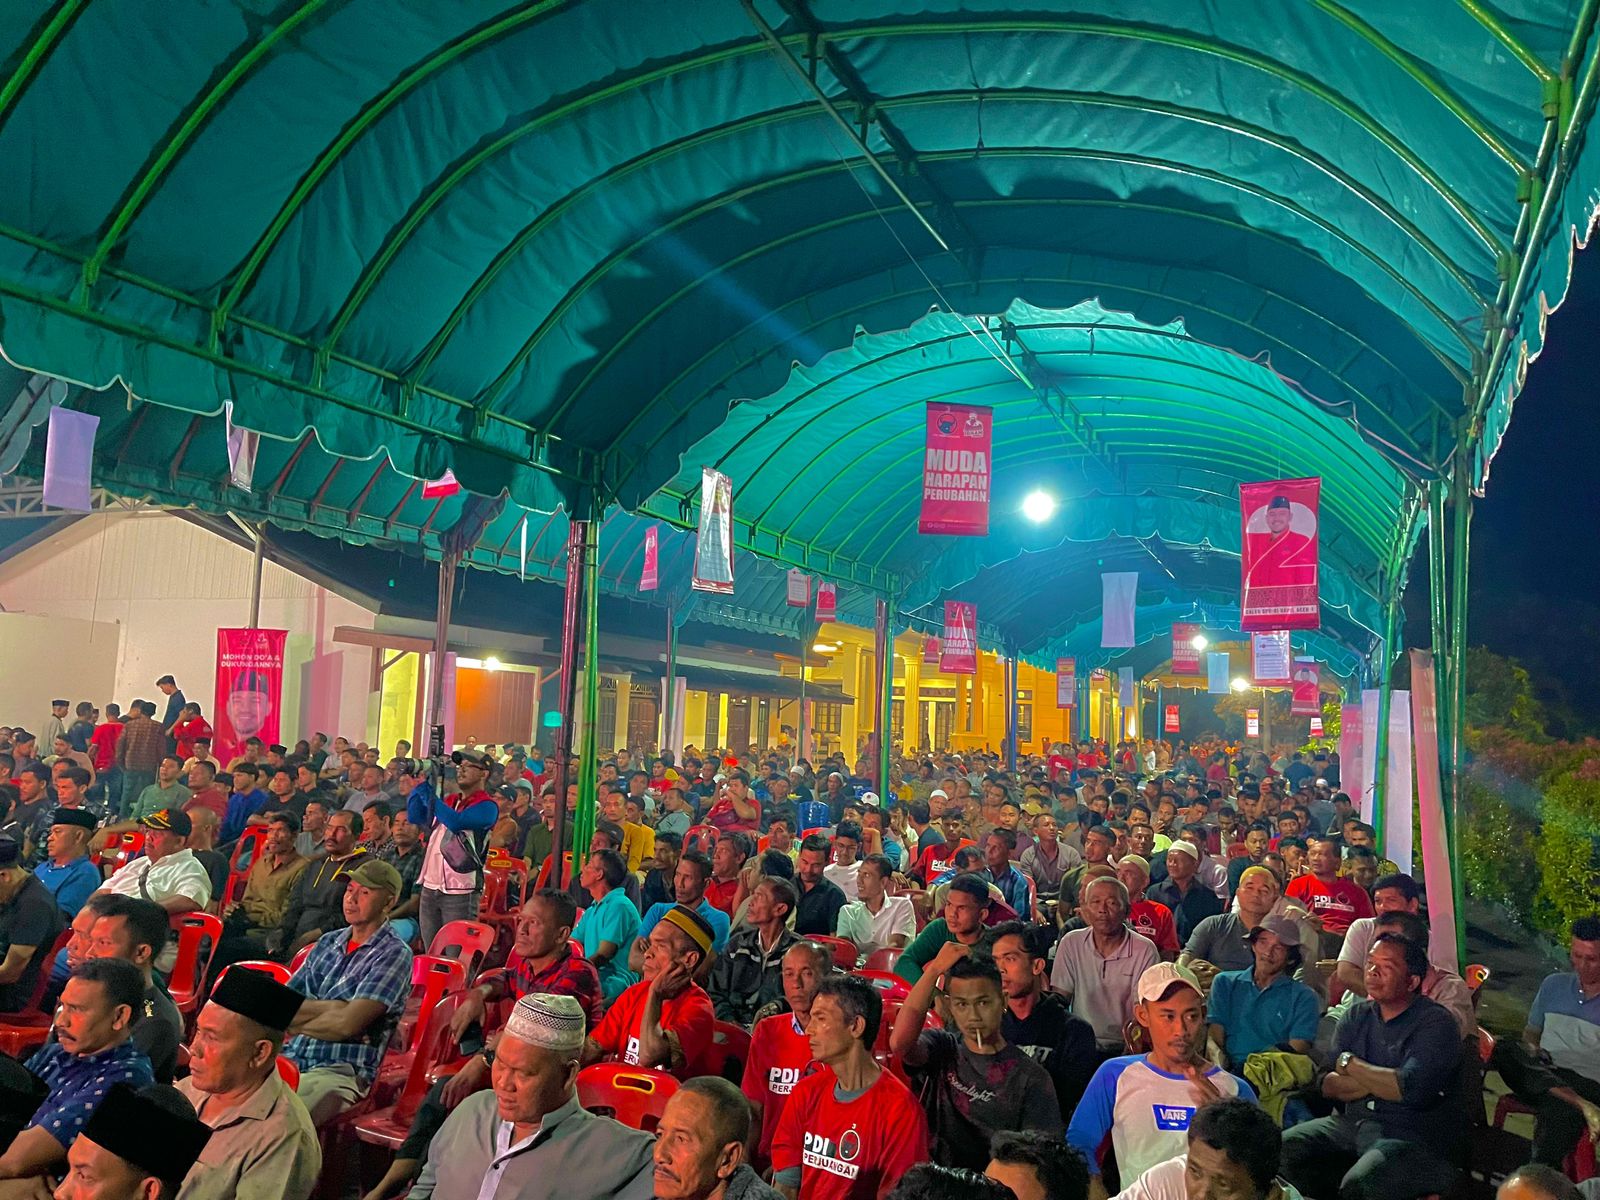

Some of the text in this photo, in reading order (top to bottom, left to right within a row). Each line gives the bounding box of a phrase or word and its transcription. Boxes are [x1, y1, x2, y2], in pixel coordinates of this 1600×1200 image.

[927, 448, 987, 474] MUDA
[925, 472, 987, 489] HARAPAN
[770, 1067, 799, 1083] PDI
[1160, 1107, 1187, 1120] VANS
[804, 1131, 830, 1156] PDI
